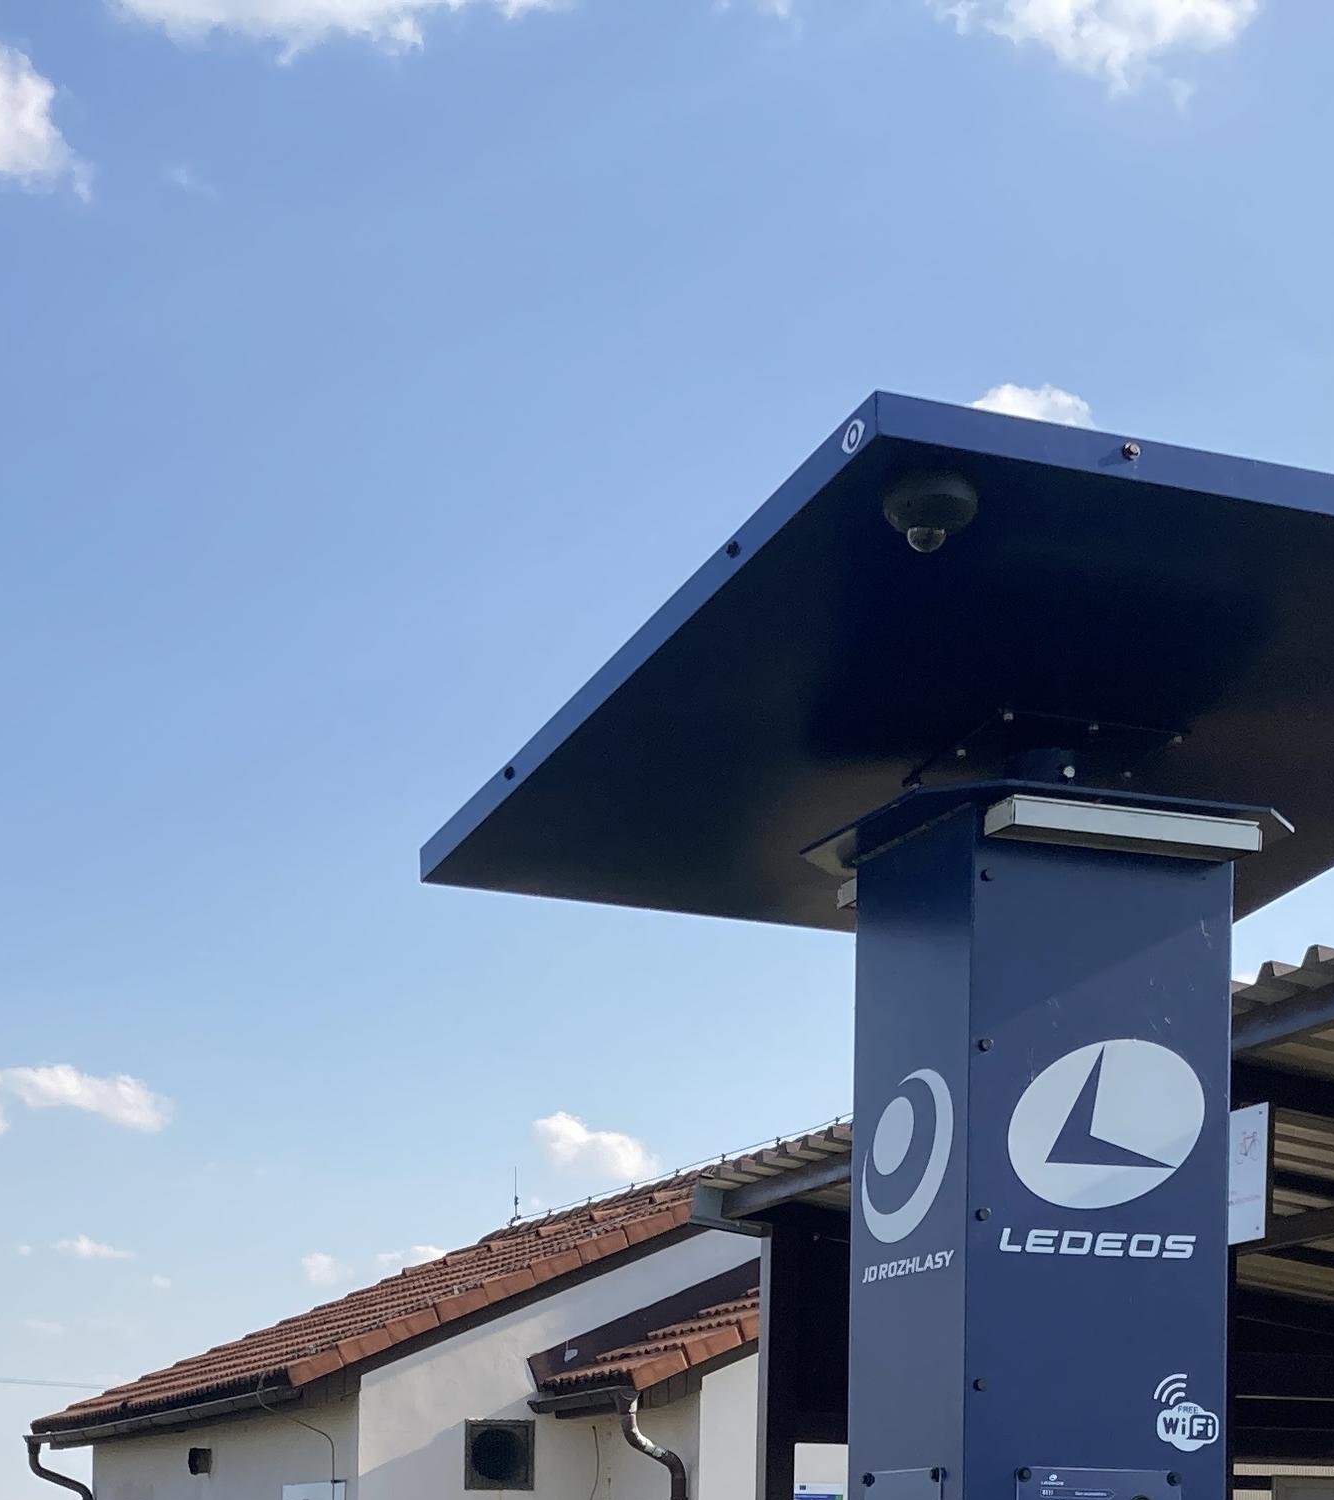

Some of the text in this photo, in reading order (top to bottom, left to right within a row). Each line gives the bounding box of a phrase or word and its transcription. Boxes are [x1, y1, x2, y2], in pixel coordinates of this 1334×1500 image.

[998, 1227, 1197, 1260] LEDEOS
[861, 1249, 955, 1284] JD ROZHLASY
[1177, 1405, 1199, 1415] FREE
[1162, 1416, 1214, 1438] WiFi
